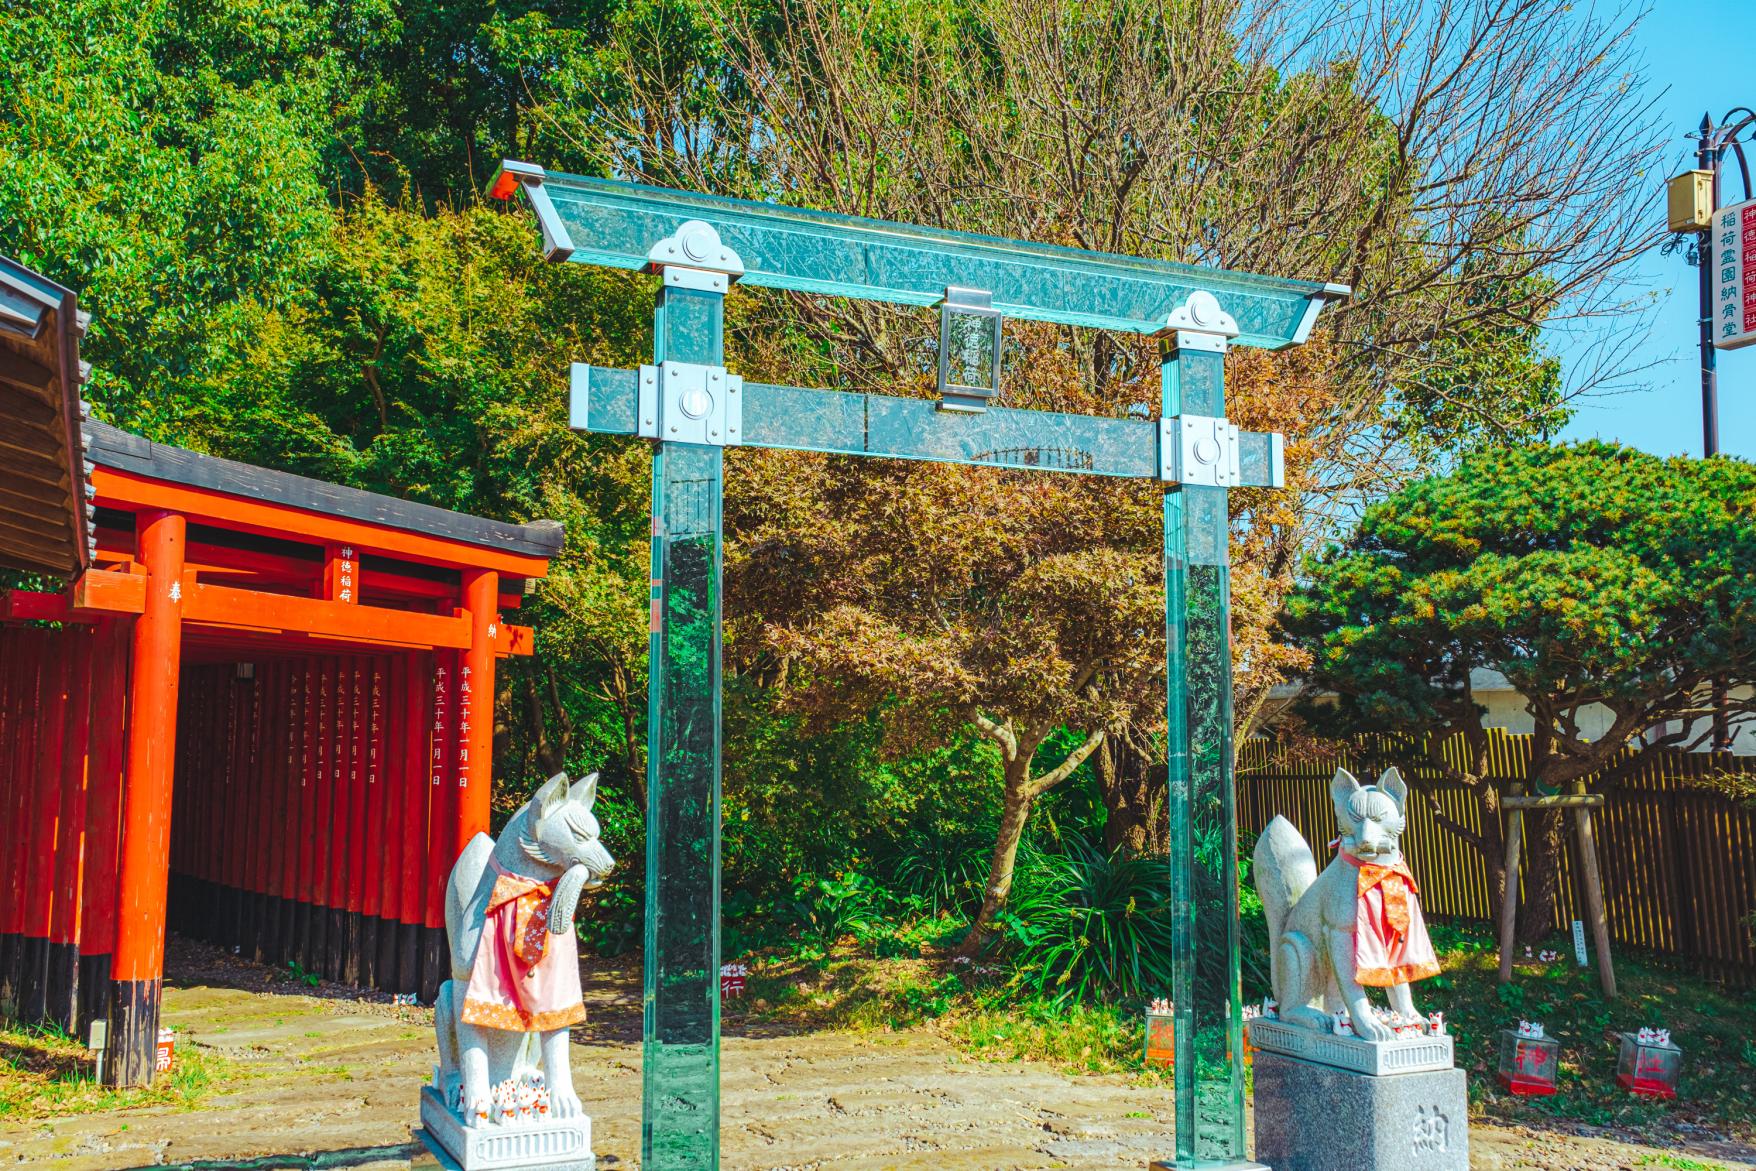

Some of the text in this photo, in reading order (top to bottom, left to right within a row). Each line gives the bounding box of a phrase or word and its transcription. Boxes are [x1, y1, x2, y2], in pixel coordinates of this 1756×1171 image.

[1720, 211, 1738, 338] 稲荷霊園納骨堂
[168, 581, 182, 603] 奉
[339, 546, 353, 603] 神徳稲荷
[369, 672, 381, 784] 平成三十年一月一日
[432, 667, 447, 786] 平成三十年一月一日
[459, 666, 472, 788] 平成三十年一月一日
